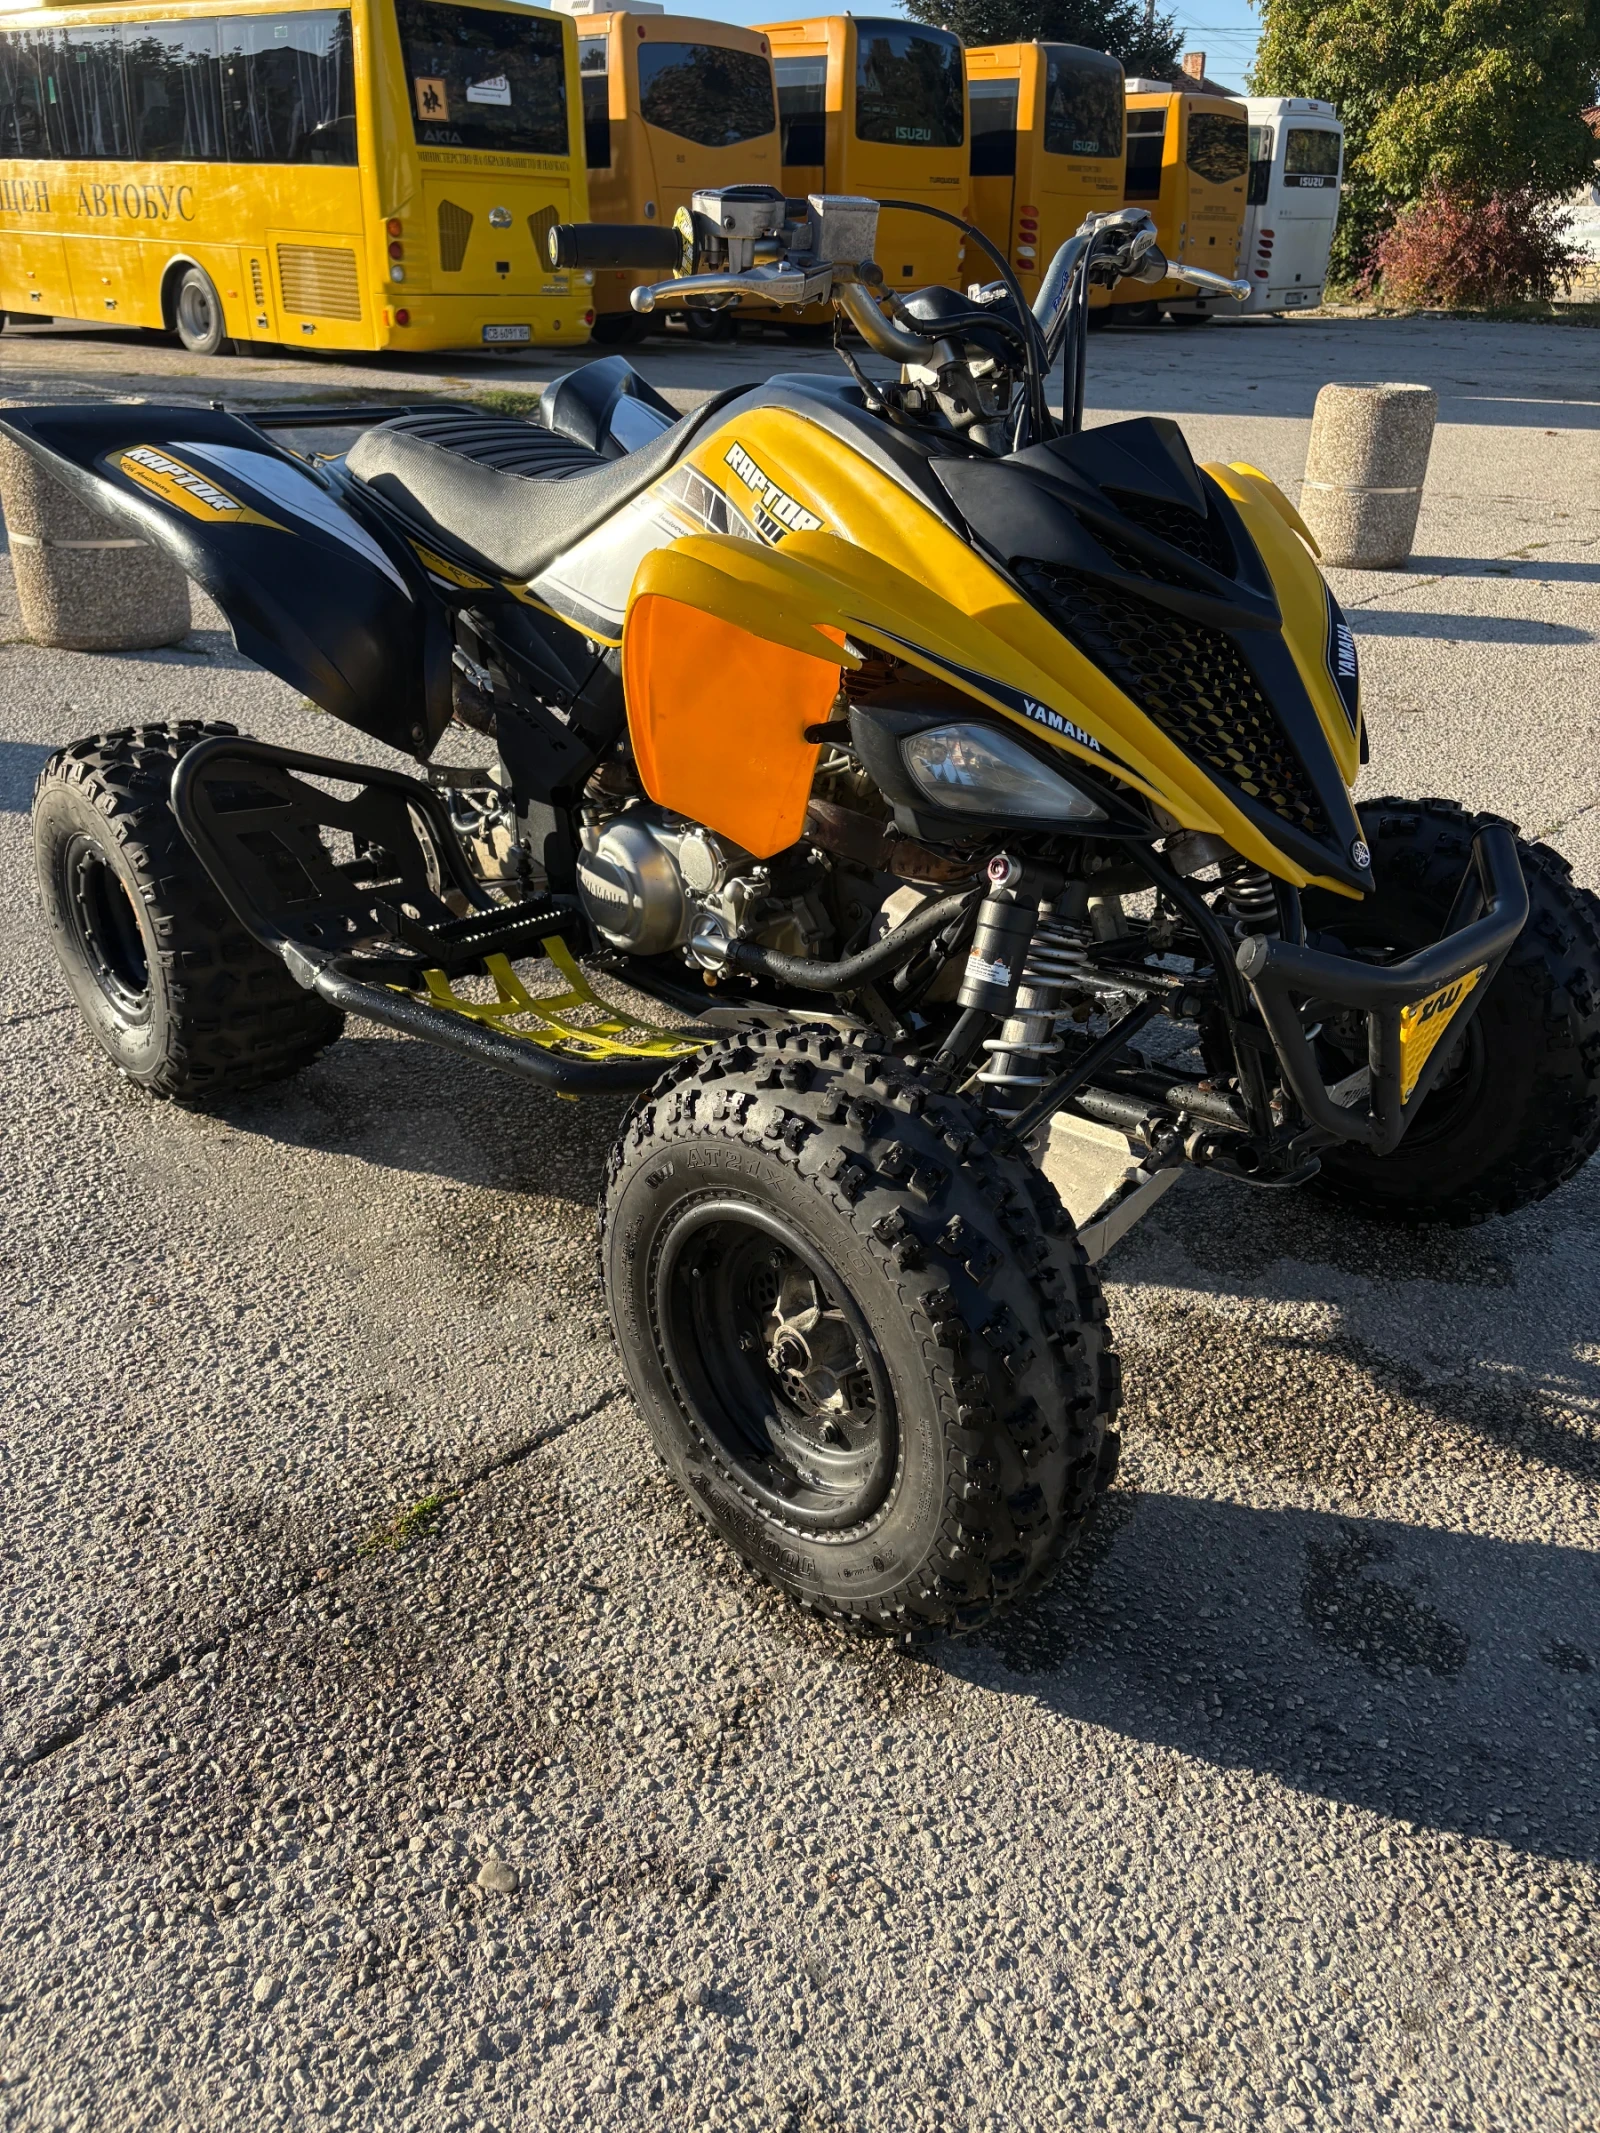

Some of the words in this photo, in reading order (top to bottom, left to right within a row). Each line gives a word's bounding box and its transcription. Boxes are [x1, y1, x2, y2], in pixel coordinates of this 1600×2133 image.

[423, 129, 463, 144] AKIA
[895, 126, 931, 141] ISUZU
[1072, 139, 1100, 153] ISUZU
[1299, 176, 1325, 187] ISUZU
[77, 183, 196, 222] АВТОБУС
[123, 447, 244, 511] RAPTOR
[136, 467, 172, 494] Anniversary
[723, 440, 825, 532] RAPTOR
[1337, 623, 1356, 678] YAMAHA
[1023, 698, 1101, 752] YAMAHA
[584, 877, 625, 912] YAMAHA
[688, 1471, 816, 1577] JOURNEY
